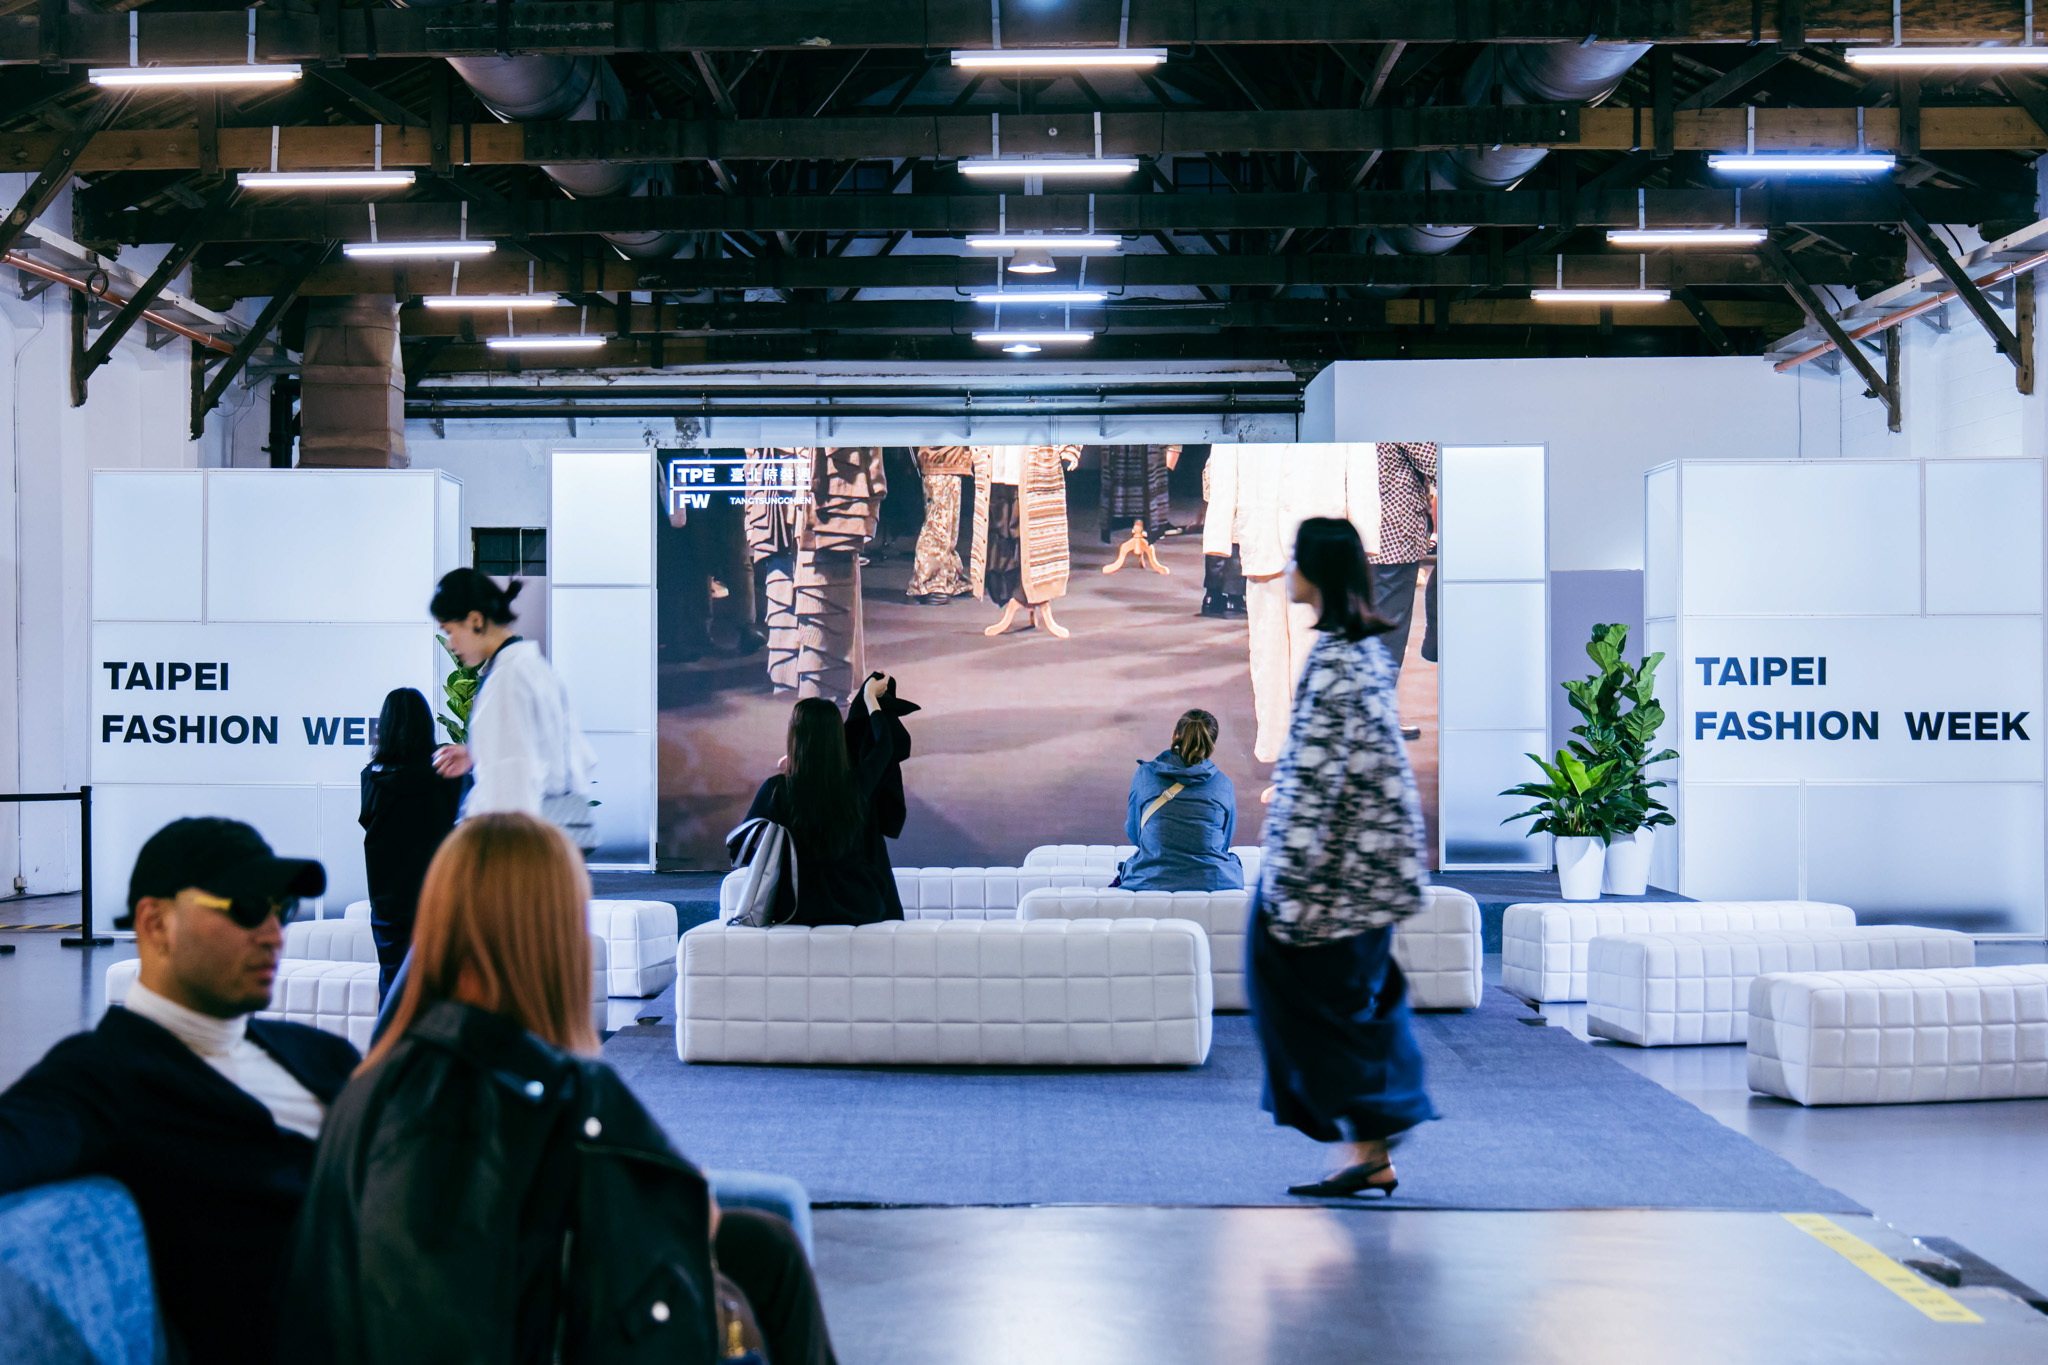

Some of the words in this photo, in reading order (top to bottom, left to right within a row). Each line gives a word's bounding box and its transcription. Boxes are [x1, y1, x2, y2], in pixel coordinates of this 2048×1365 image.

[677, 468, 715, 483] TPE
[679, 494, 710, 508] FW
[103, 662, 229, 690] TAIPEI
[1695, 657, 1827, 686] TAIPEI
[102, 714, 278, 744] FASHION
[1695, 711, 1879, 741] FASHION
[1905, 711, 2031, 741] WEEK
